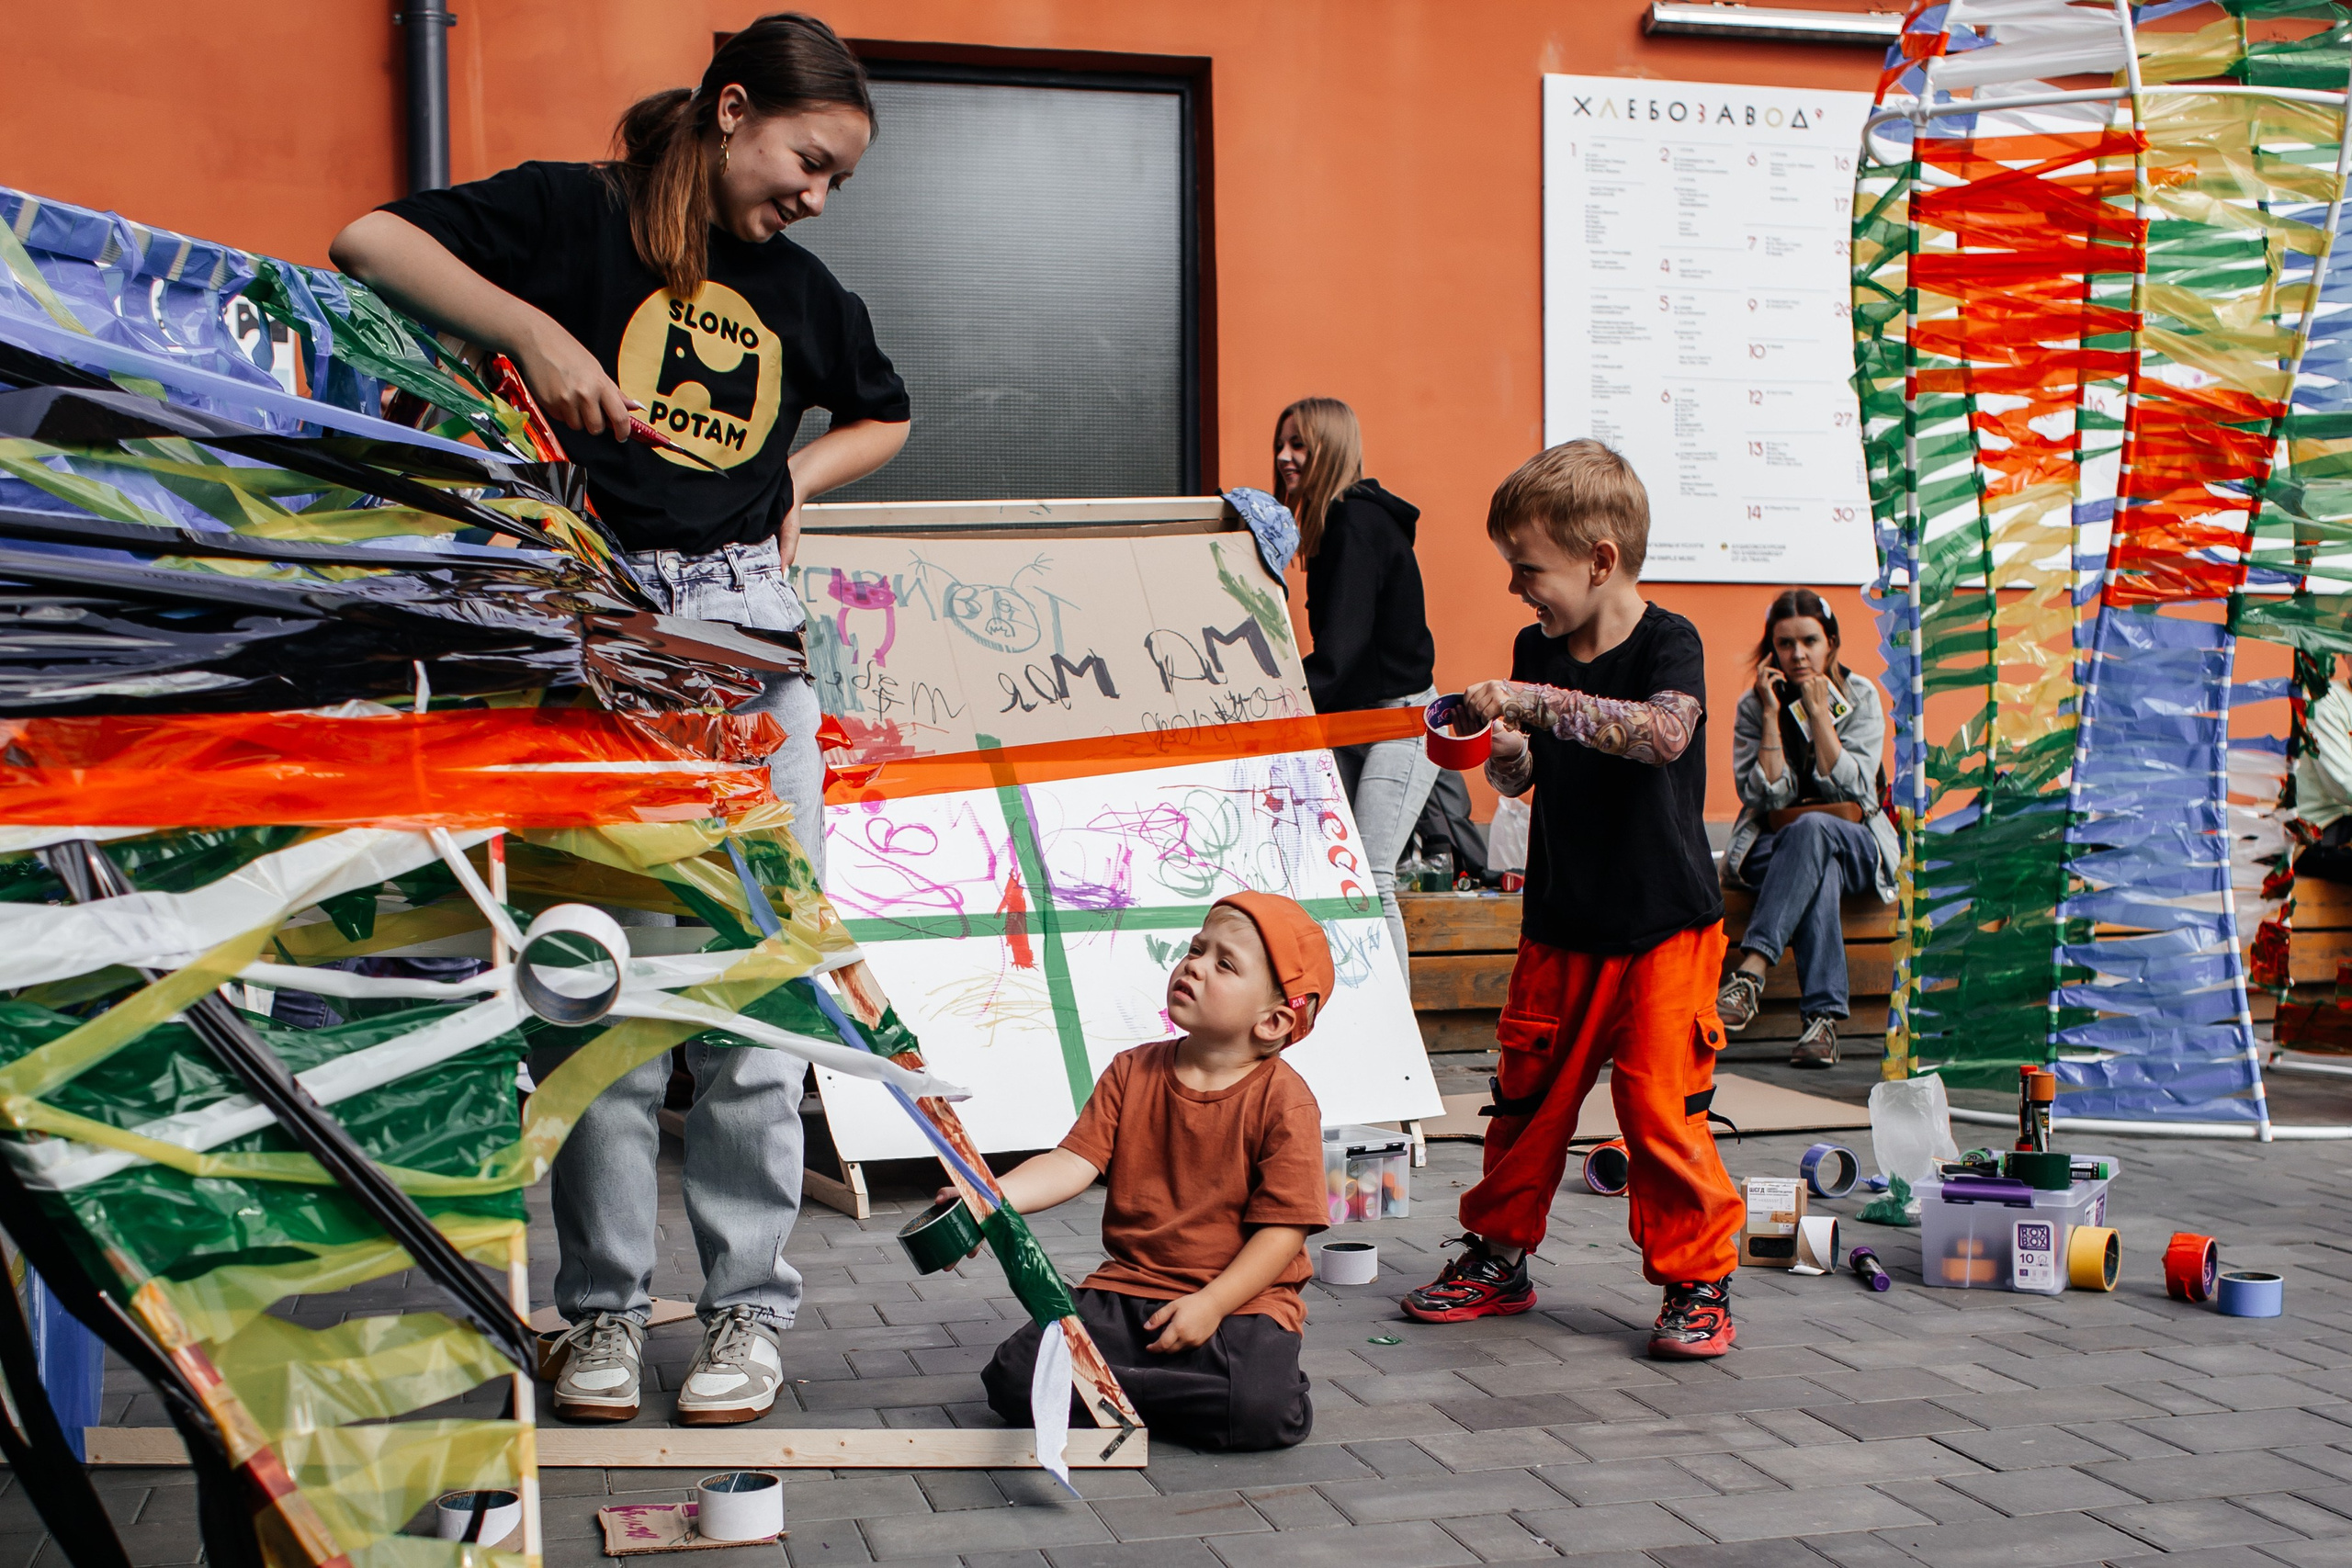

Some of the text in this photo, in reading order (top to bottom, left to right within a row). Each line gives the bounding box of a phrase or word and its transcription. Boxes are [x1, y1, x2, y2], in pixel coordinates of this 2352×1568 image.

[1570, 141, 1577, 158] 1
[1659, 147, 1670, 163] 2
[1834, 154, 1850, 171] 16
[1834, 197, 1849, 212] 17
[1747, 236, 1757, 251] 7
[1659, 259, 1670, 274] 4
[1659, 296, 1669, 312] 5
[1747, 299, 1758, 314] 9
[669, 299, 760, 350] SLONO
[1748, 344, 1766, 359] 10
[1748, 389, 1764, 405] 12
[649, 400, 748, 451] POTAM
[1834, 412, 1852, 428] 27
[1748, 441, 1764, 457] 13
[1747, 505, 1761, 521] 14
[1832, 507, 1855, 522] 30
[2020, 1227, 2046, 1237] ROX
[2020, 1237, 2046, 1247] BOX
[2019, 1253, 2034, 1264] 10
